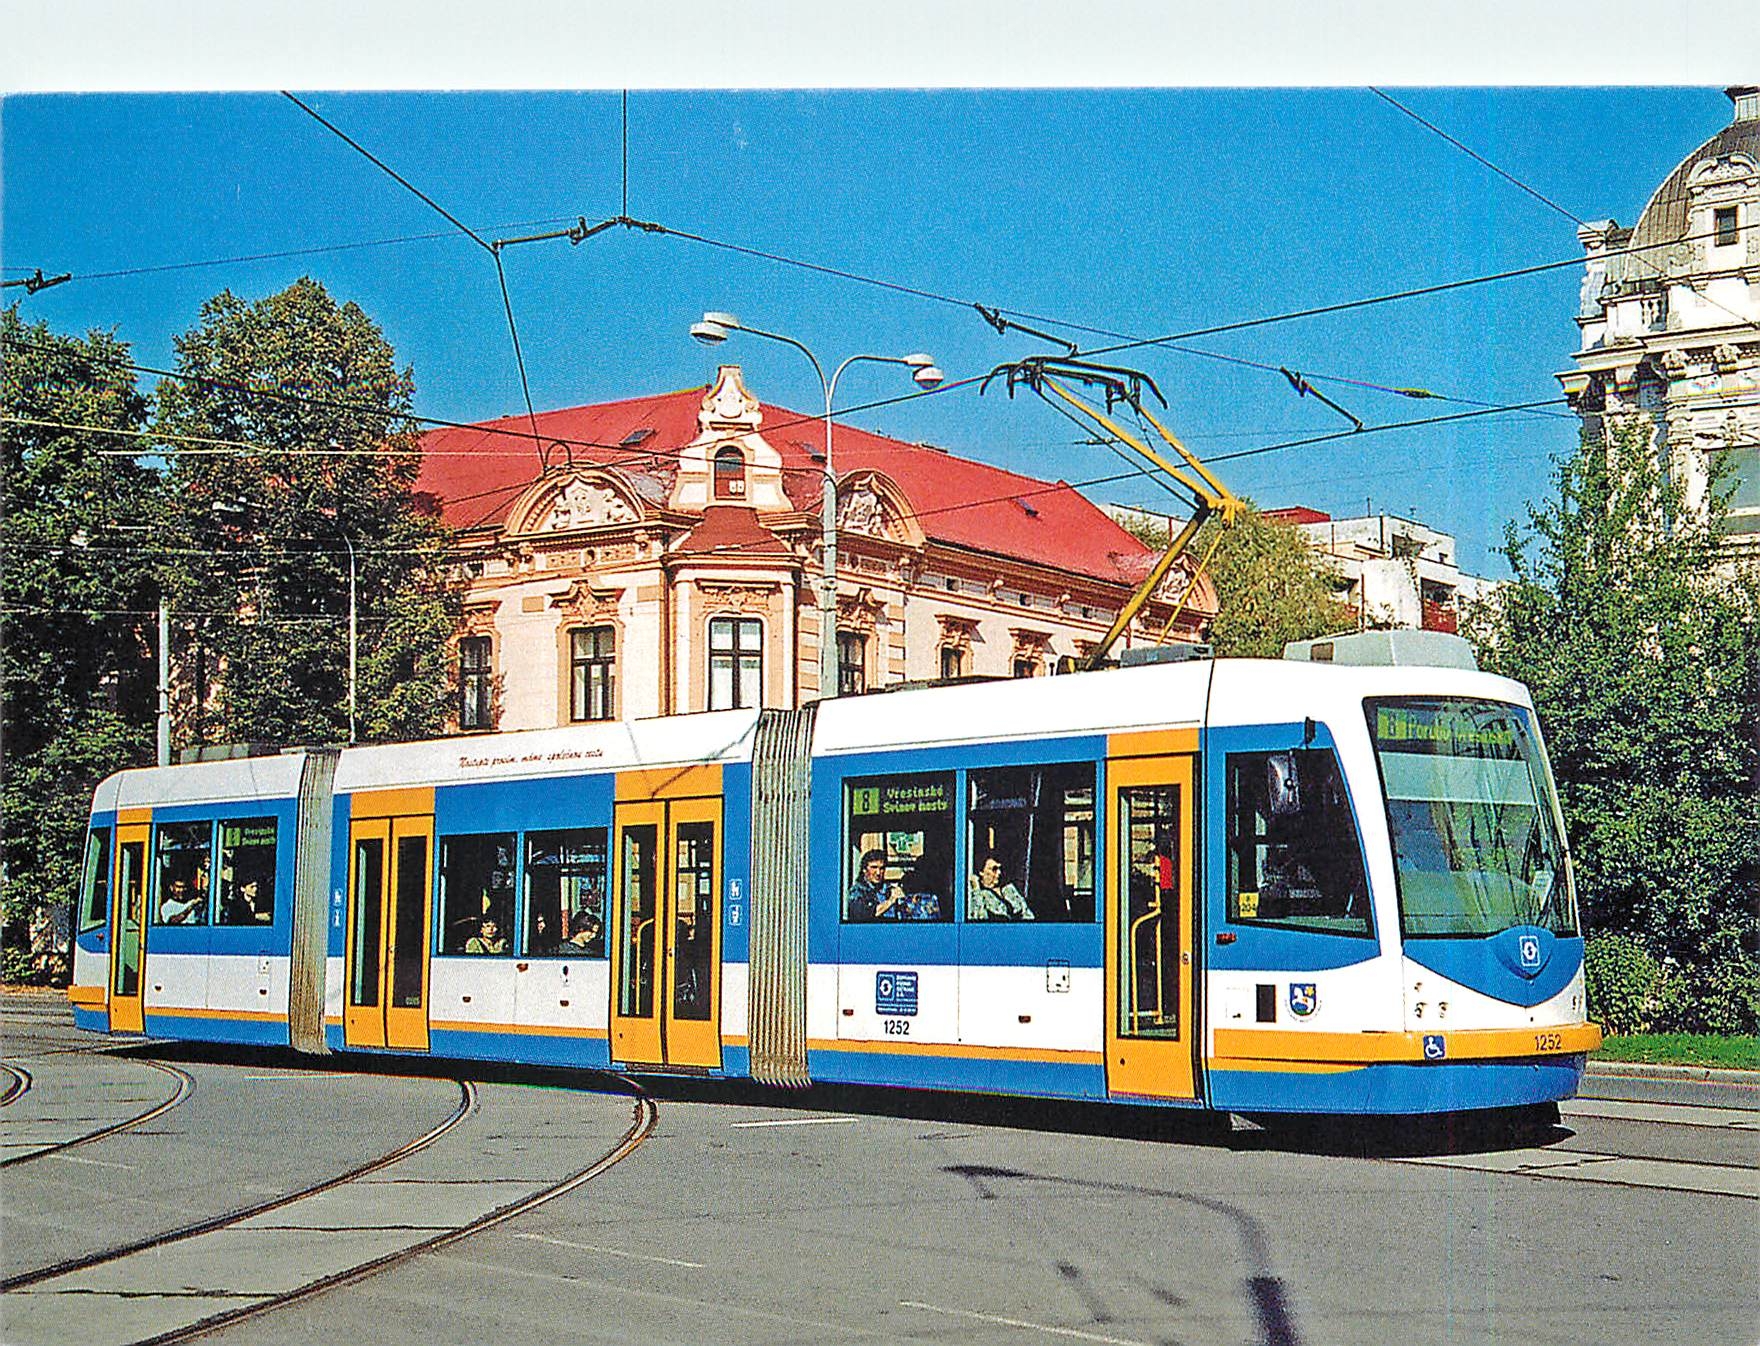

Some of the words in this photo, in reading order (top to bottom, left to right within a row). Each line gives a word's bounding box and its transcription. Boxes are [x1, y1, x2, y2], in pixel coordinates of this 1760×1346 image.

[862, 790, 870, 812] 8
[883, 1019, 910, 1036] 1252
[1534, 1033, 1562, 1052] 1252
